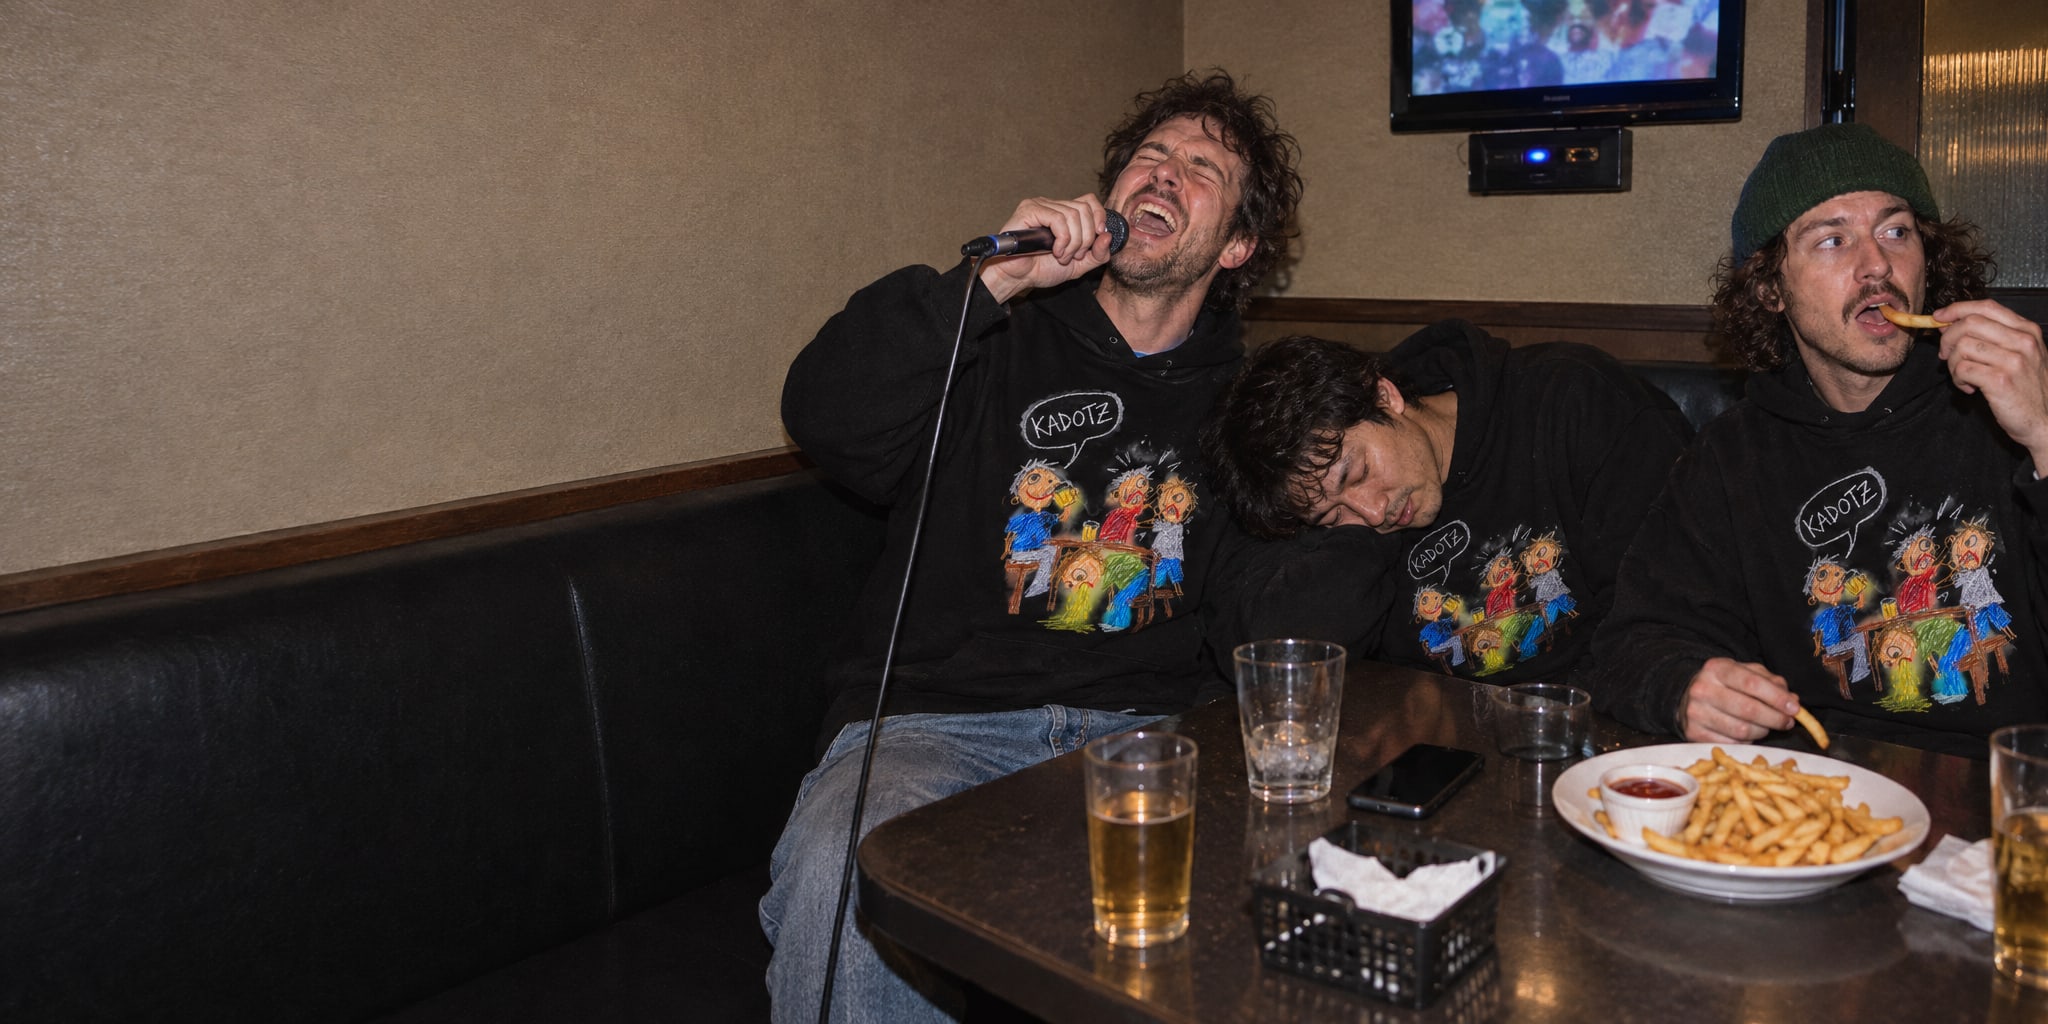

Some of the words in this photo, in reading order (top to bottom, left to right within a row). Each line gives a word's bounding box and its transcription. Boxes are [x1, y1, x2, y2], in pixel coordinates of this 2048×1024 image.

[1030, 402, 1113, 439] KADOTZ
[1802, 479, 1878, 539] KADOTZ
[1411, 528, 1464, 573] KADOTZ
